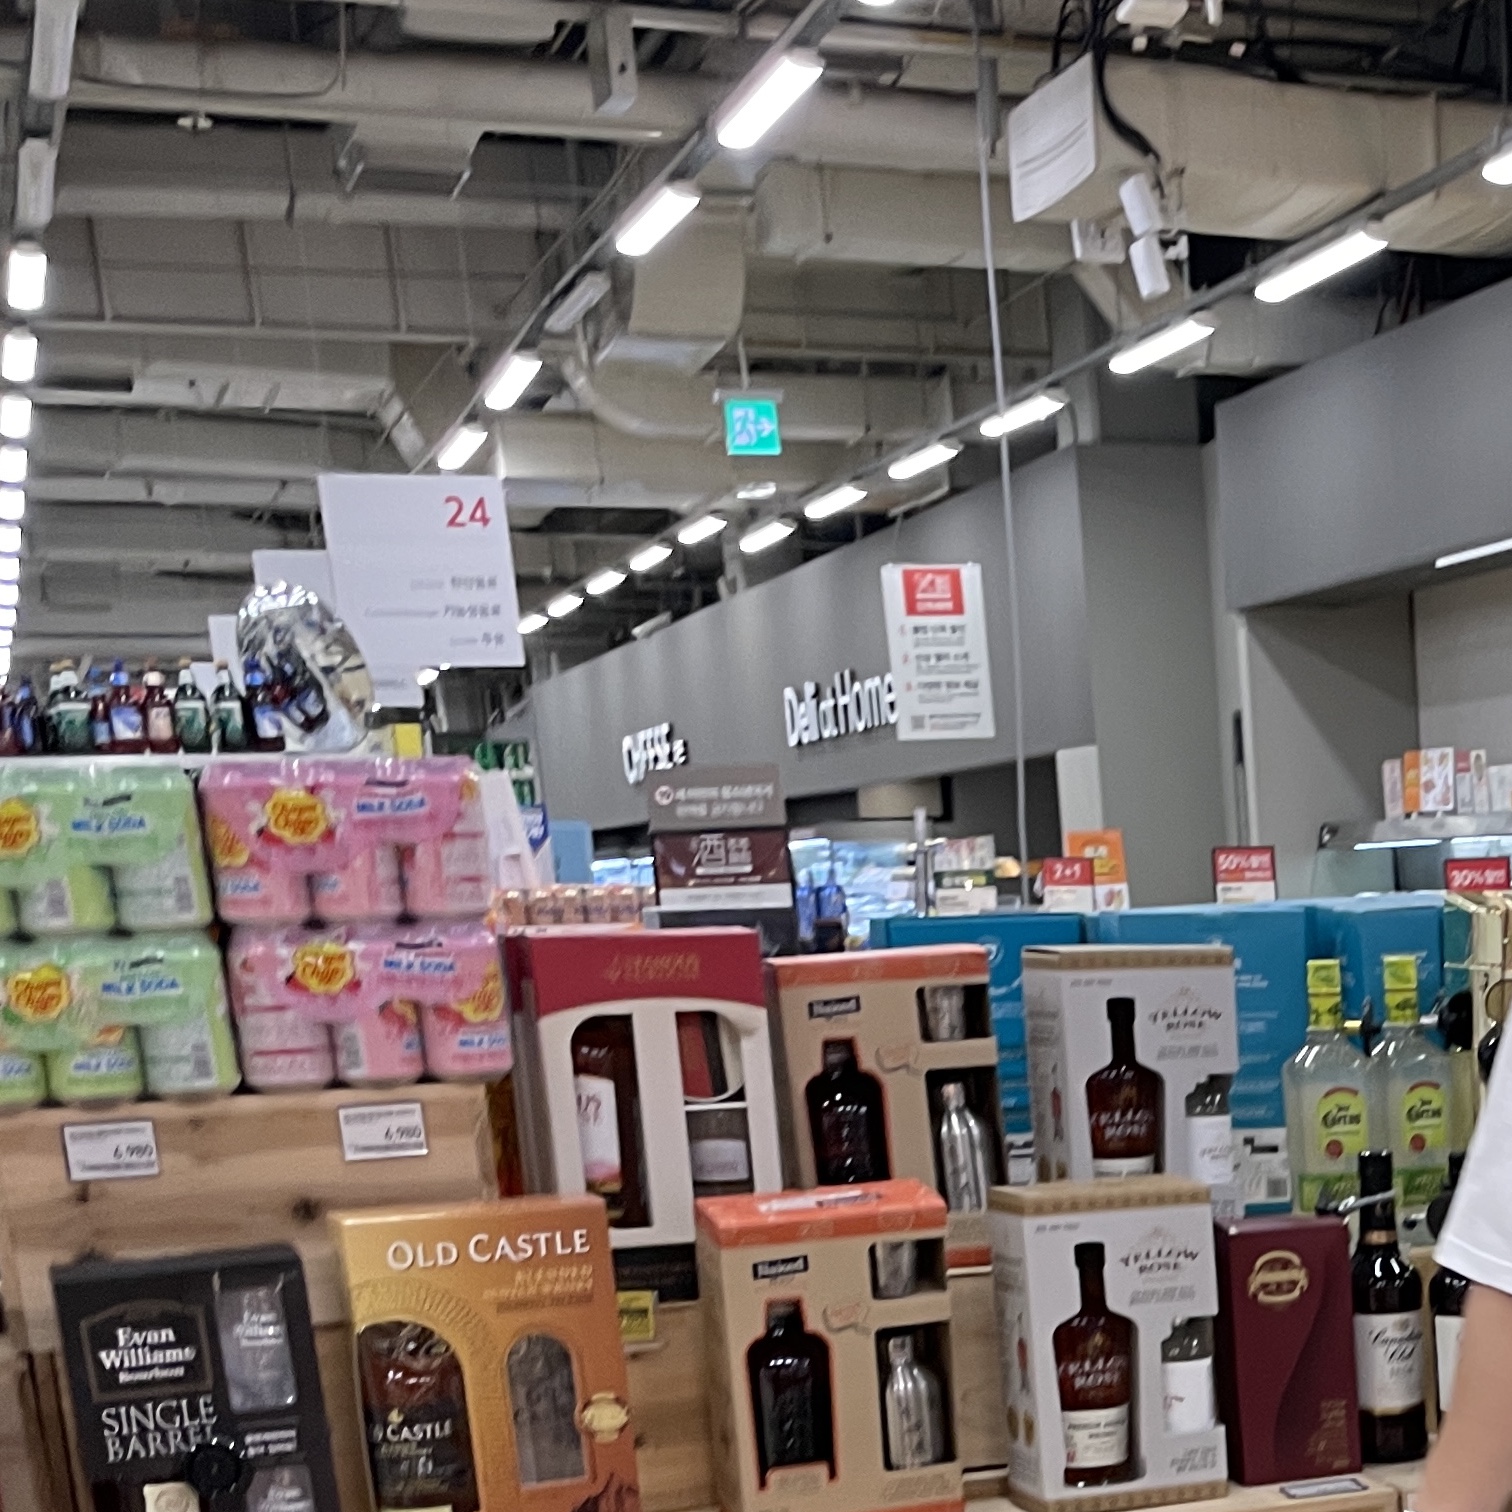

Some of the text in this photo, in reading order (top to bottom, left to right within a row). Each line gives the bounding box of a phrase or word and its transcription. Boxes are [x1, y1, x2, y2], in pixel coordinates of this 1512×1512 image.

[444, 495, 492, 529] 24
[386, 1228, 591, 1271] OLD CASTLE
[116, 1326, 176, 1345] Evan
[99, 1345, 197, 1372] Williams
[102, 1393, 218, 1438] SINGLE
